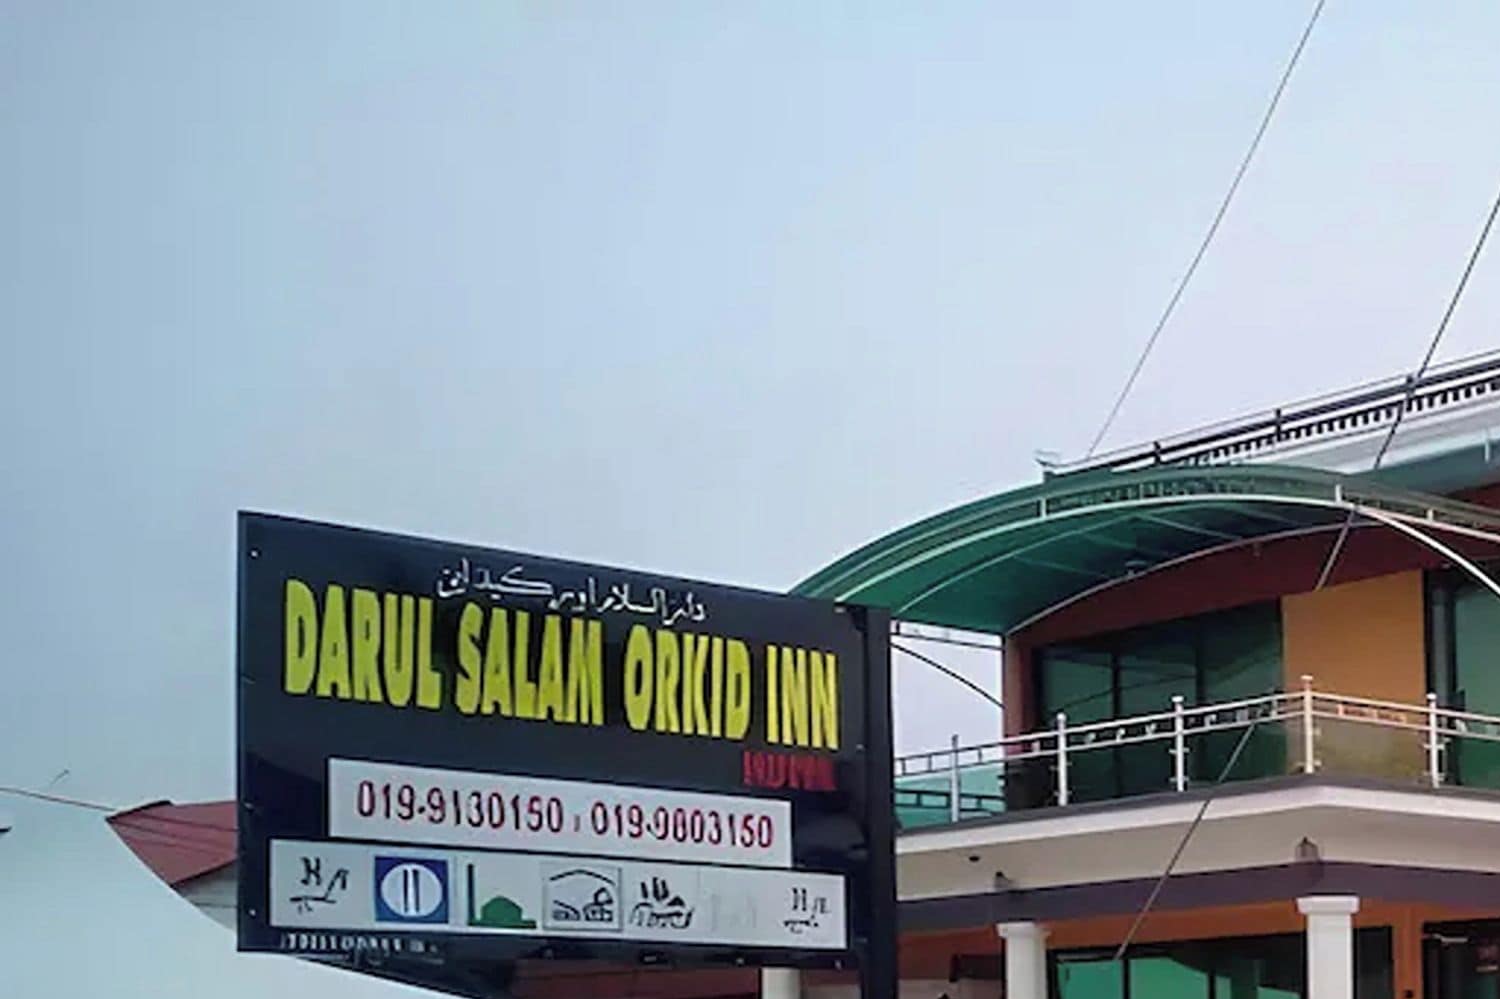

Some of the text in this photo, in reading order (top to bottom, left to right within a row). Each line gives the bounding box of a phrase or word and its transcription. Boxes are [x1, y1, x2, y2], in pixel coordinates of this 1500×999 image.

[284, 579, 839, 750] DARUL SALAM ORKID INN
[357, 780, 564, 833] 019-9130150
